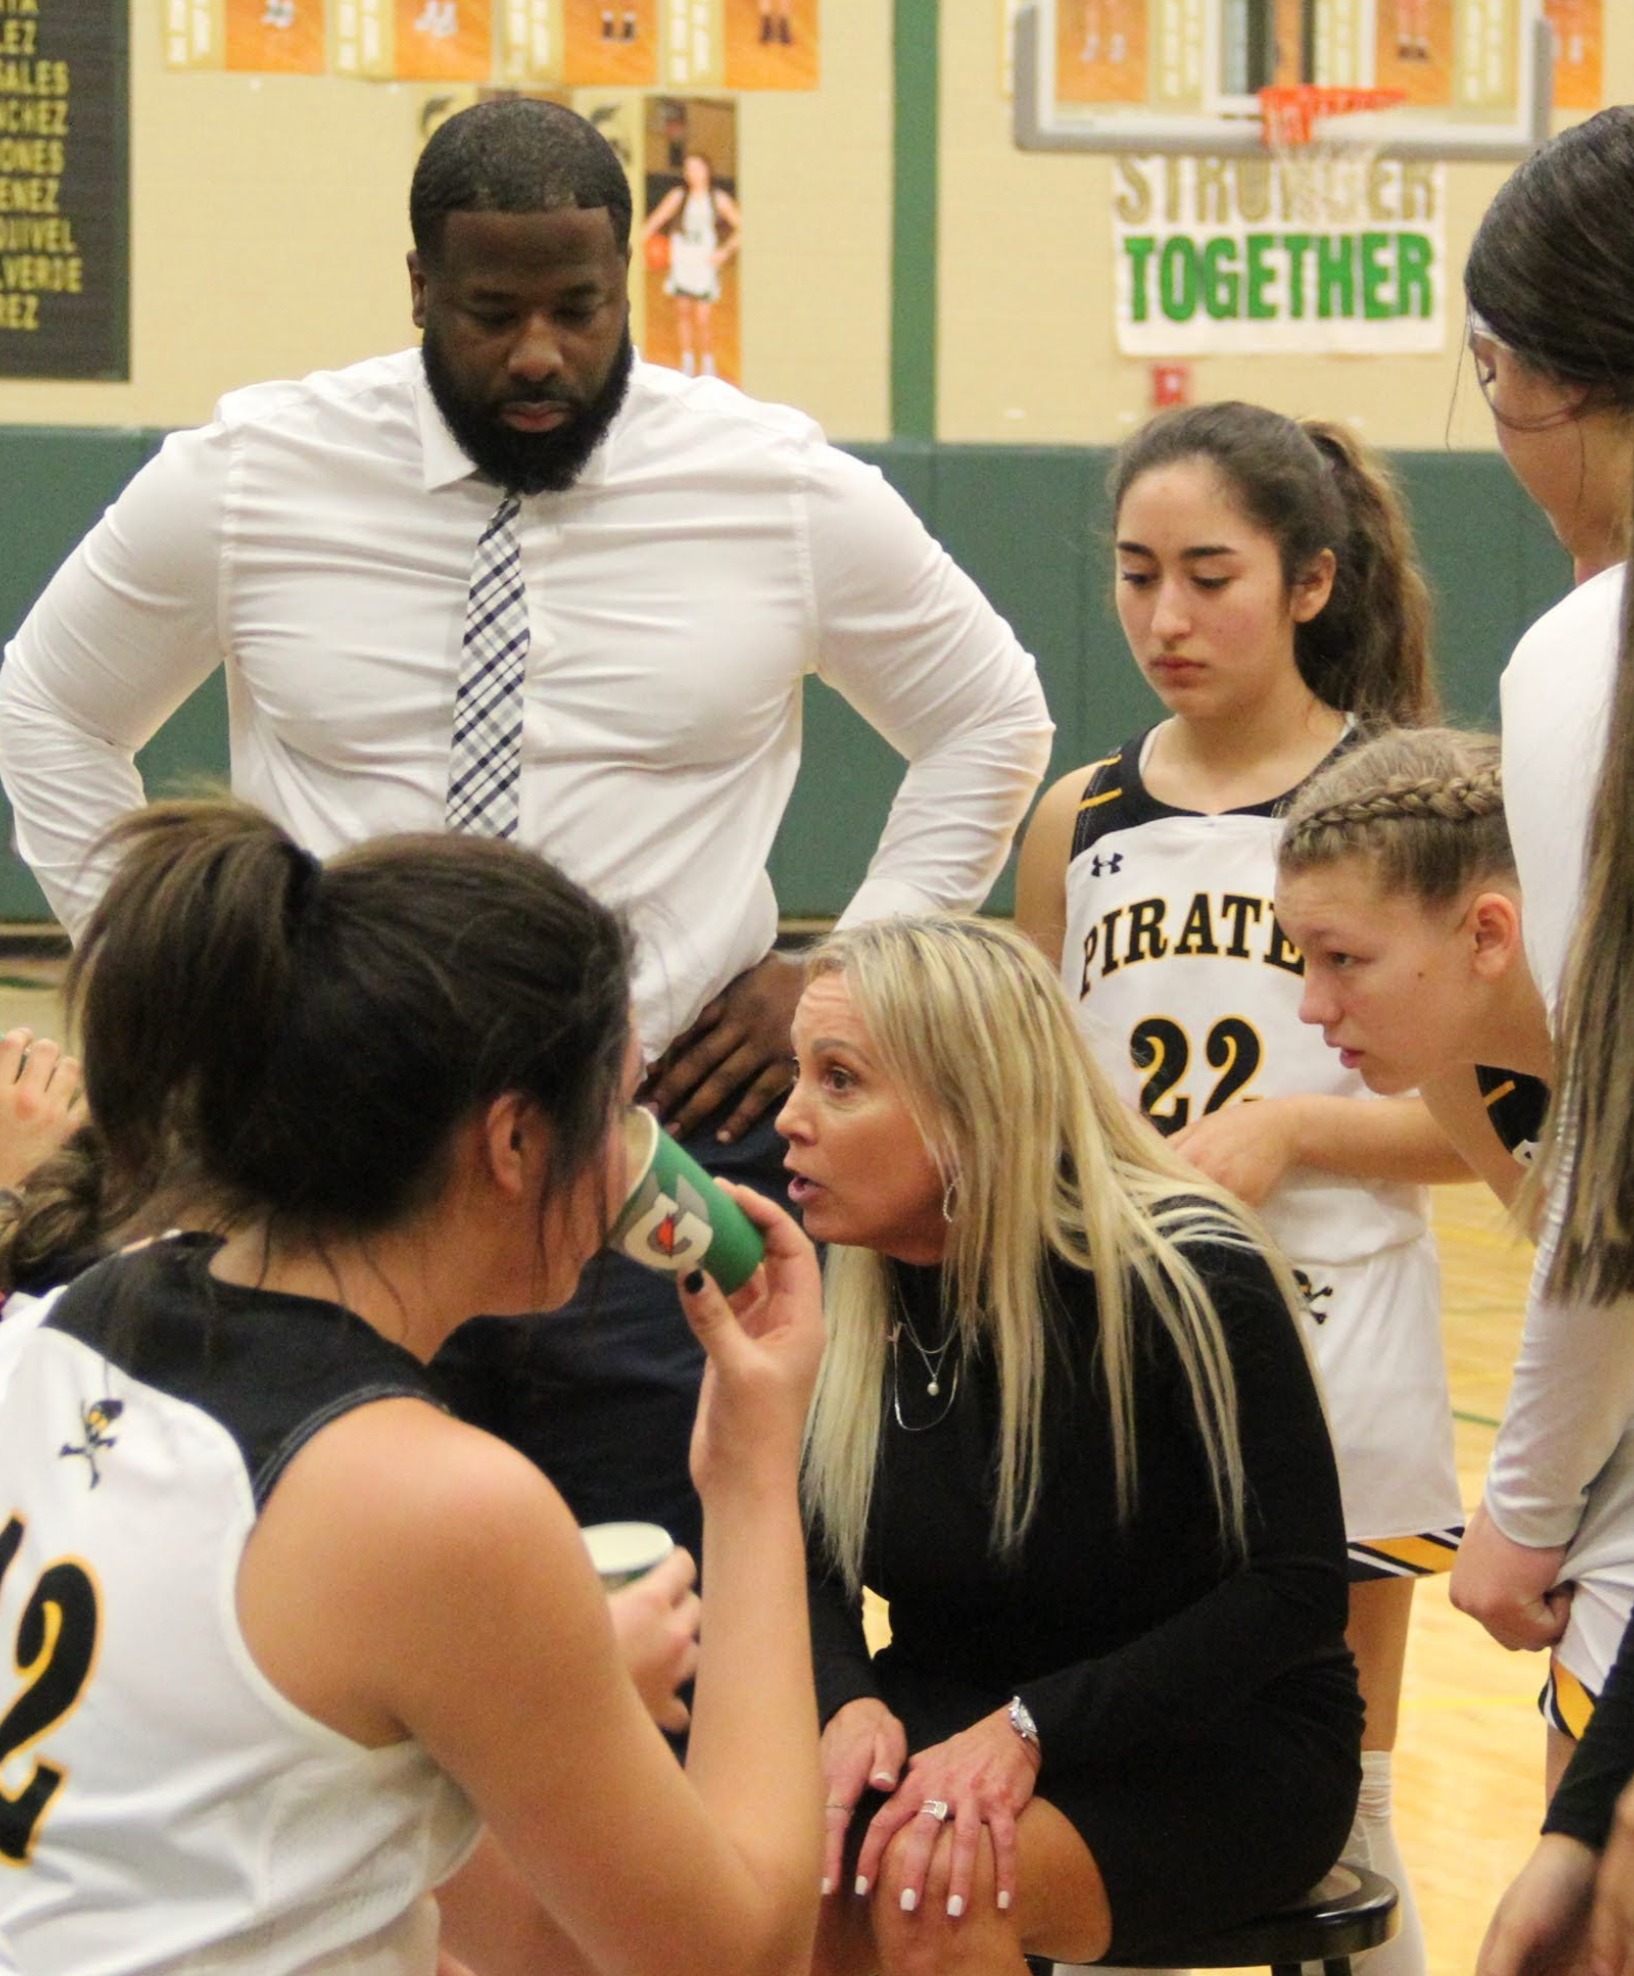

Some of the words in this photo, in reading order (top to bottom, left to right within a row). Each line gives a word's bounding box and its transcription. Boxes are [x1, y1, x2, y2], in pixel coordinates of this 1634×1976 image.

[0, 19, 37, 55] EZ
[0, 255, 83, 293] VERDE
[1123, 232, 1434, 322] TOGETHER
[1130, 1015, 1264, 1139] 22
[0, 1508, 104, 1867] 2
